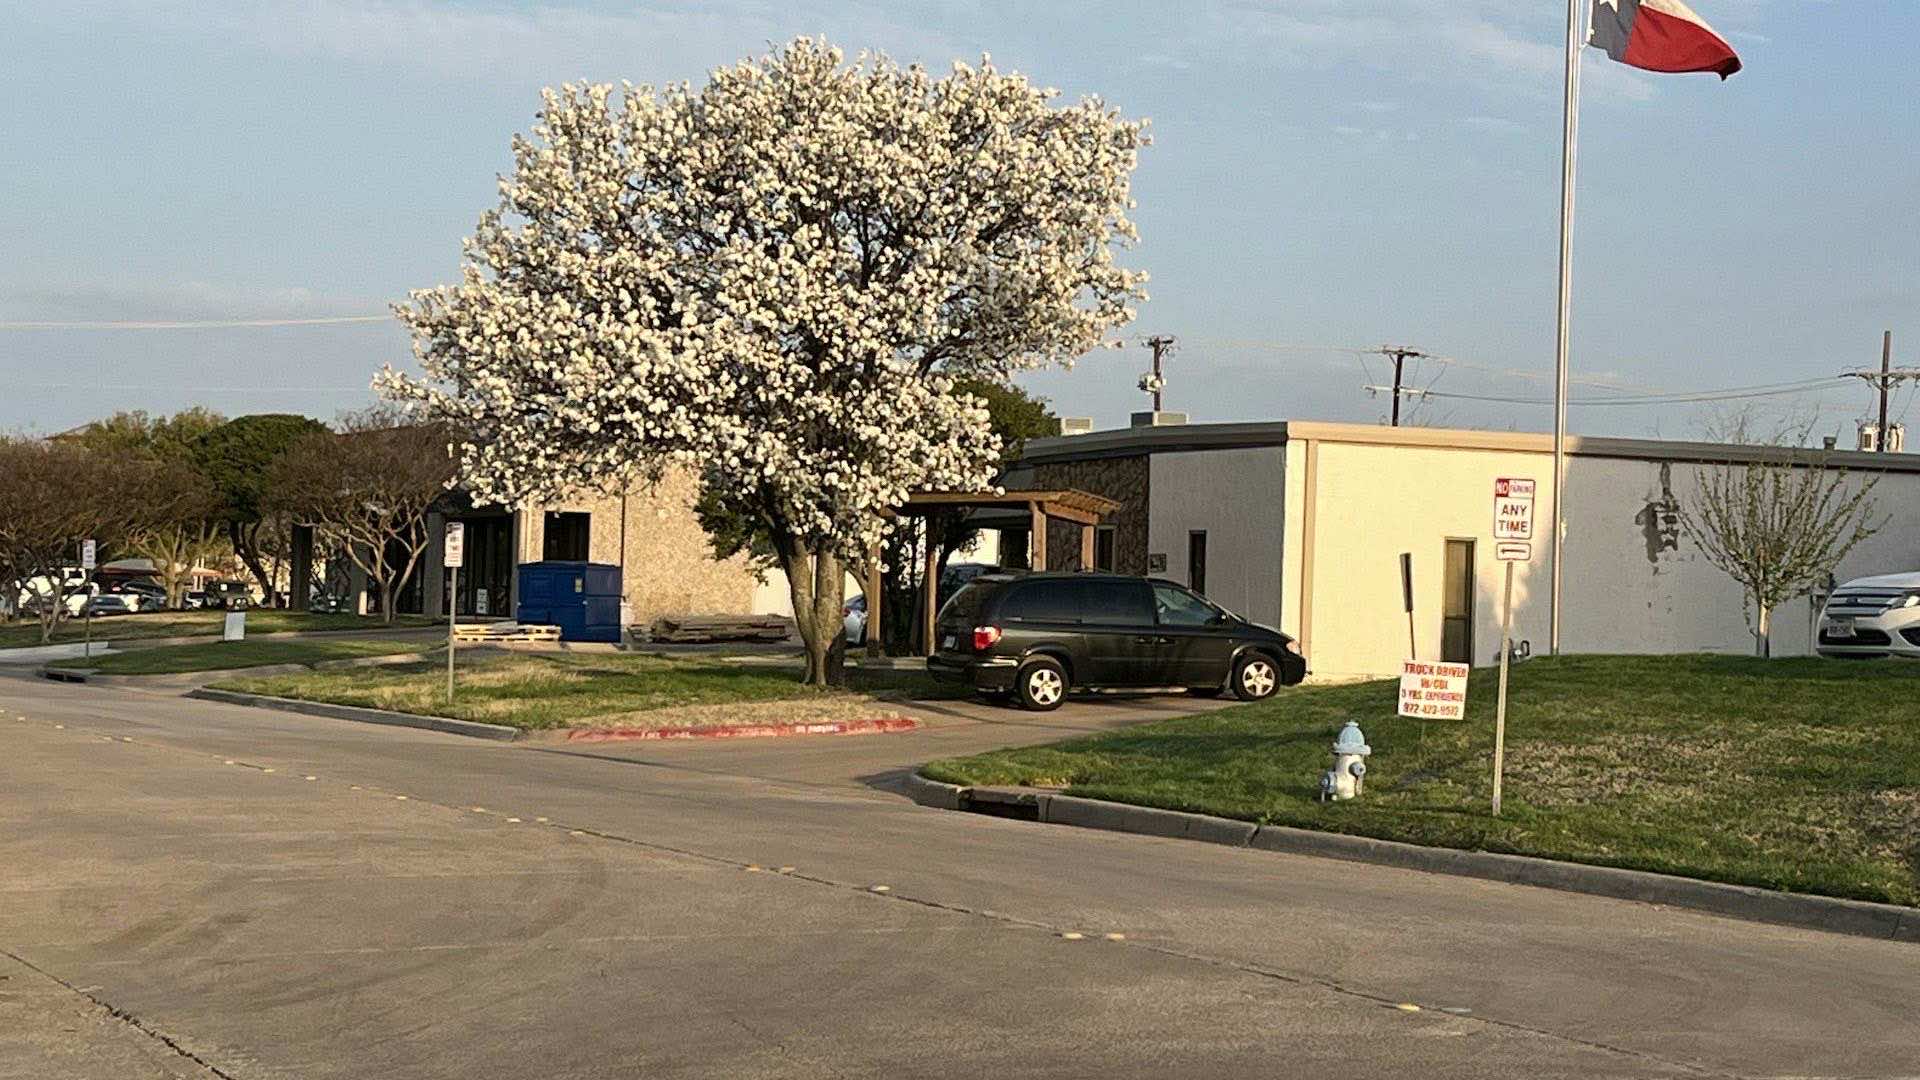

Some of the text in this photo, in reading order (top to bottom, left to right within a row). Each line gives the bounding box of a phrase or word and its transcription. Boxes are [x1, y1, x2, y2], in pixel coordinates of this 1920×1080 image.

[1496, 481, 1508, 495] NO
[1501, 504, 1527, 516] ANY
[1498, 520, 1528, 533] TIME
[1405, 663, 1466, 677] TRUCK DRIVER
